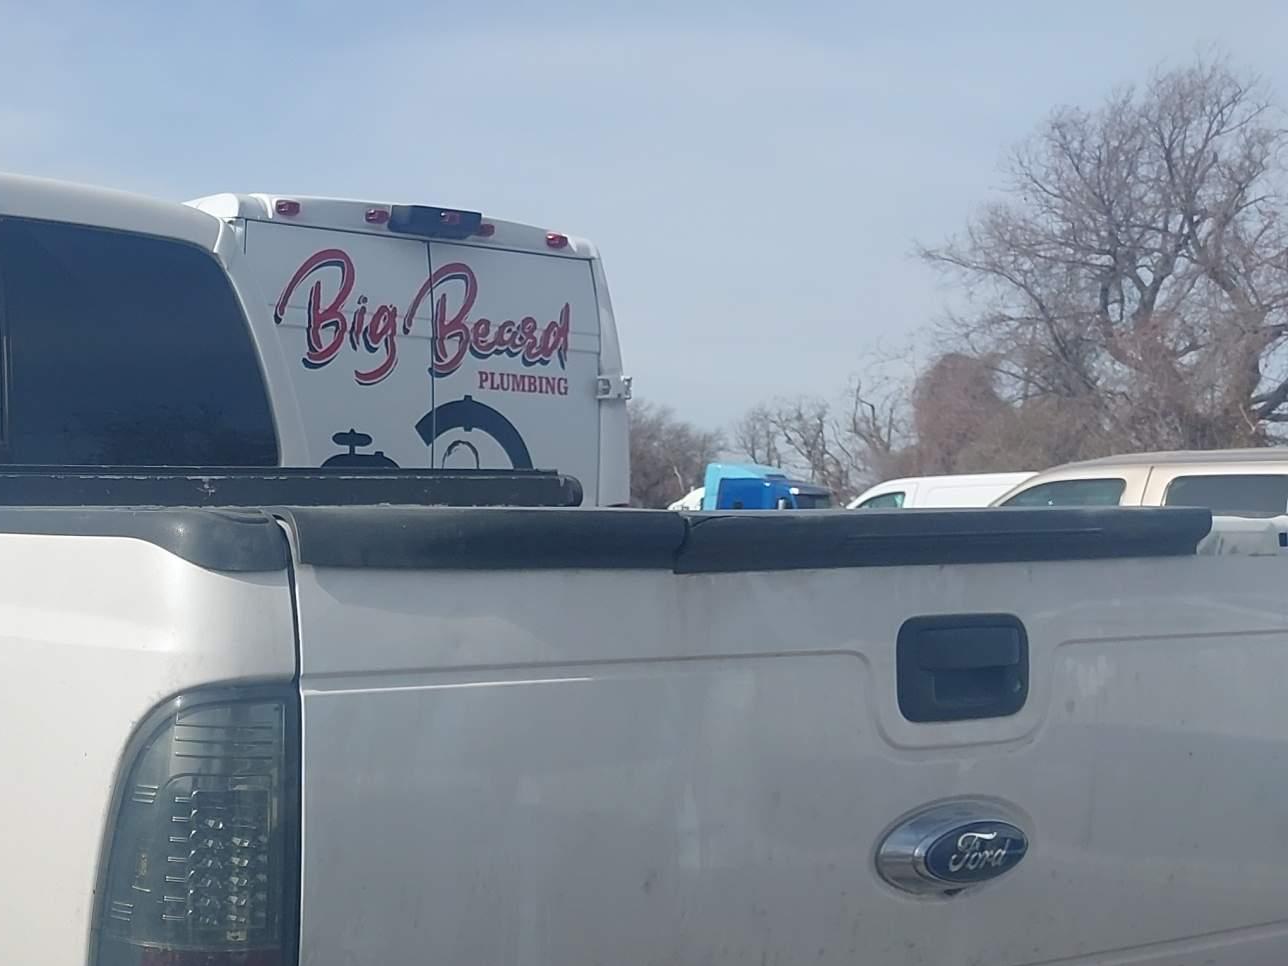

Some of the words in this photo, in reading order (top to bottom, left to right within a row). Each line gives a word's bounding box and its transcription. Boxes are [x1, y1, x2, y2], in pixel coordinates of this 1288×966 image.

[274, 248, 400, 386] Big
[403, 262, 570, 378] Beard
[478, 371, 569, 396] PLUMBING
[948, 831, 1009, 872] Ford
